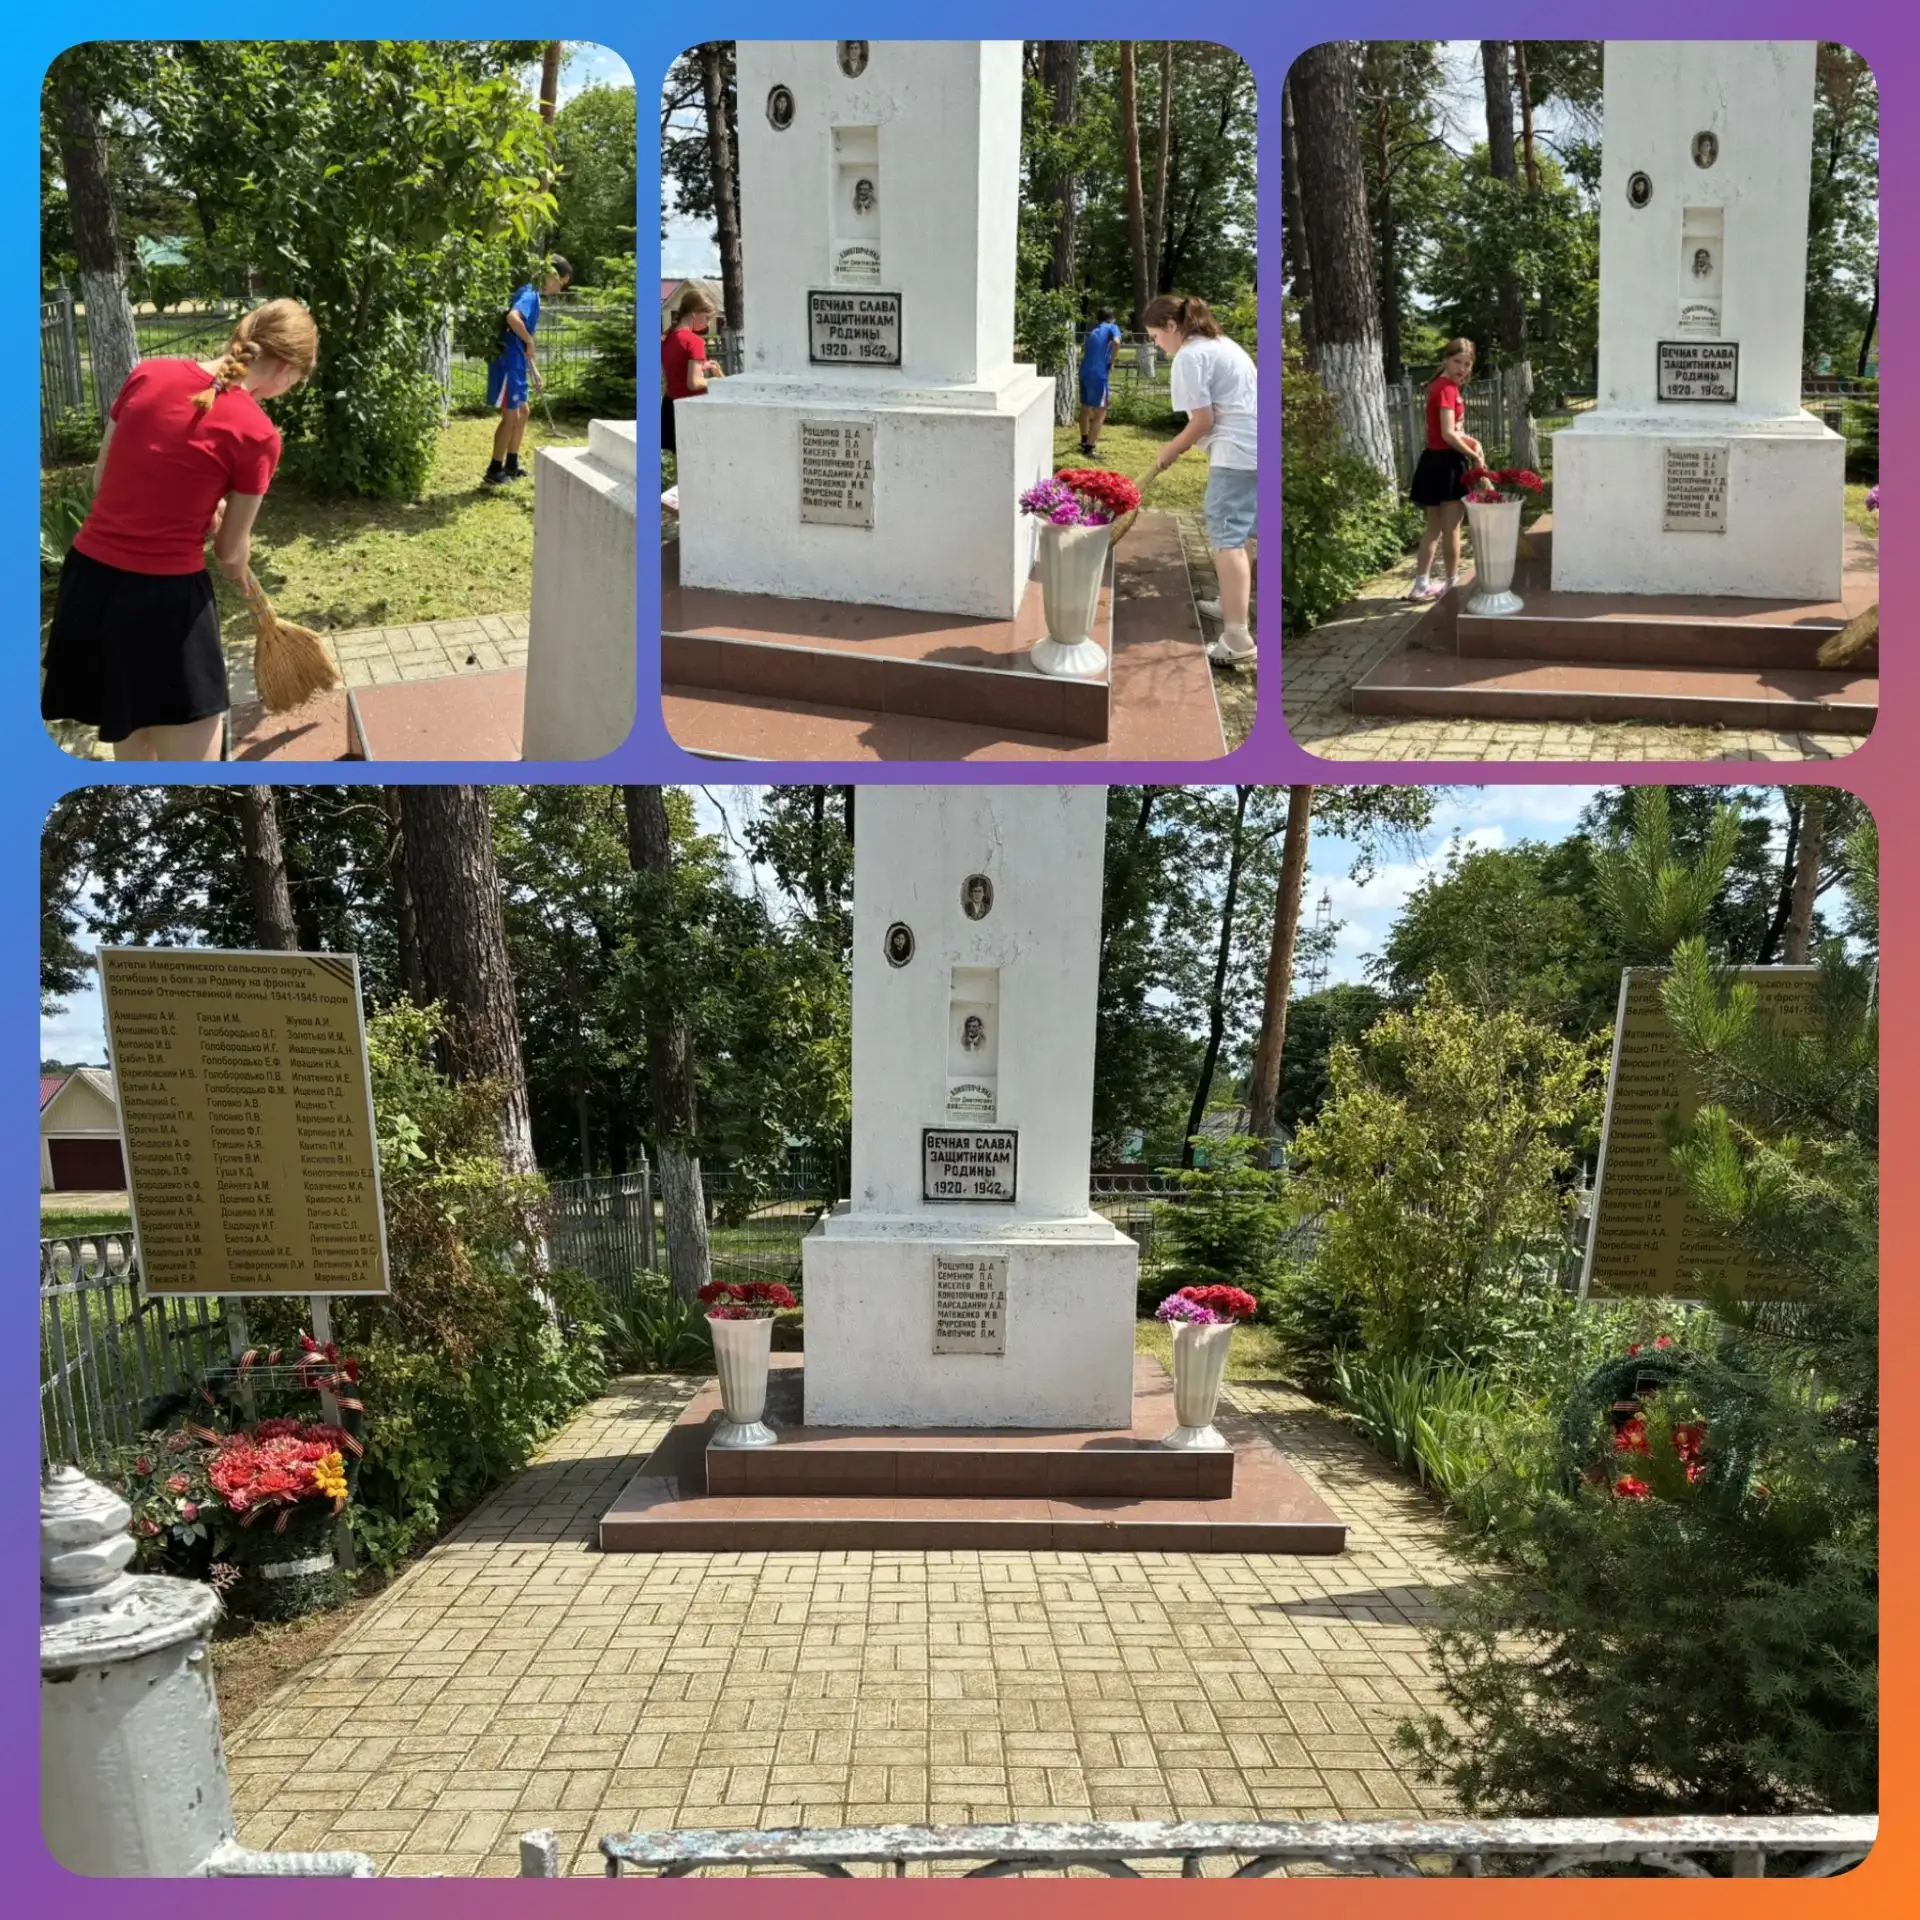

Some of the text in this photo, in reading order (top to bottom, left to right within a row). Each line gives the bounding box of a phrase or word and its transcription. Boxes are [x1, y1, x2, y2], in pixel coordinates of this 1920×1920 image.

[812, 298, 896, 312] ВЕЧНАЯ СЛАВА
[815, 312, 893, 327] ЗАЩИТНИКАМ
[1661, 347, 1734, 359] ВЕЧНАЯ СЛАВА
[1663, 359, 1732, 370] ЗАЩИТНИКАМ
[270, 991, 317, 1002] 1941-1945
[927, 1135, 1012, 1149] ВЕЧНАЯ СЛАВА
[930, 1149, 1009, 1164] ЗАЩИТНИКАМ
[943, 1163, 995, 1178] РОДИНЫ
